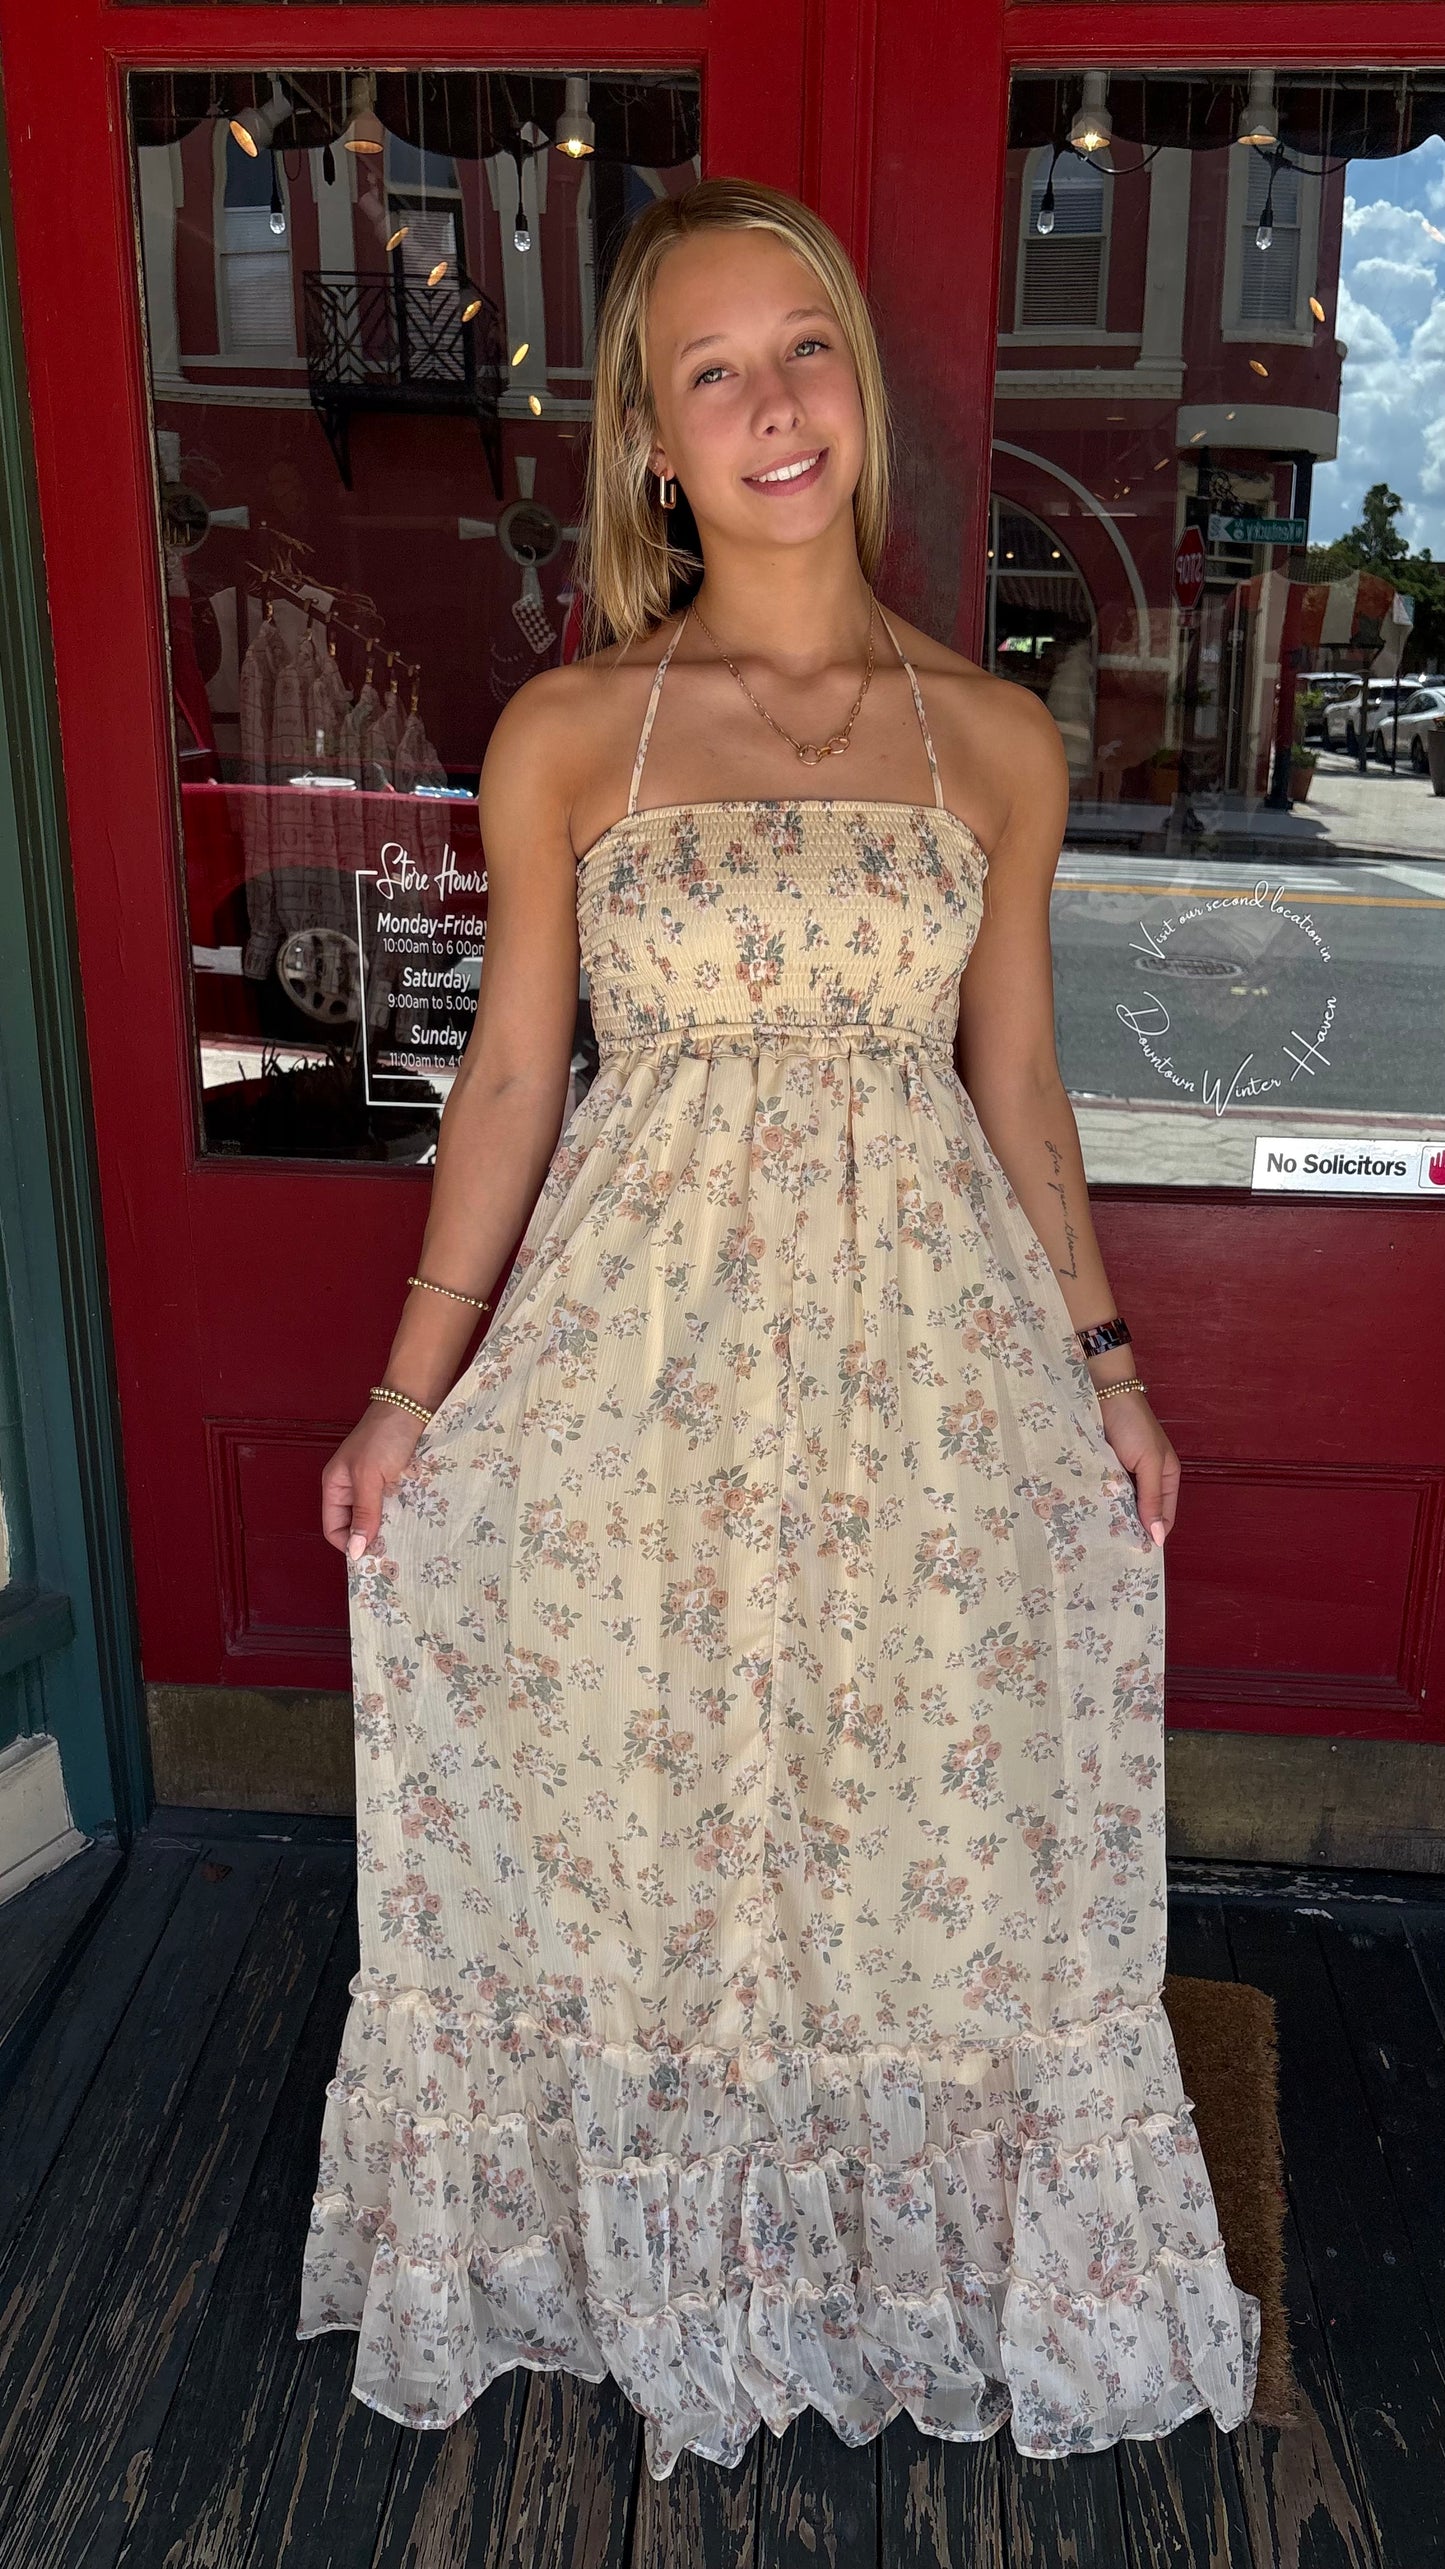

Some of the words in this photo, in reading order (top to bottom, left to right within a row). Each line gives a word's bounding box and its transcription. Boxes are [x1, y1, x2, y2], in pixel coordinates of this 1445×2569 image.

[376, 842, 430, 900] Store
[434, 843, 488, 902] Hours
[1129, 918, 1176, 960] Visit
[1179, 907, 1203, 925] our
[1206, 880, 1269, 912] second
[1270, 886, 1322, 947] location
[1319, 945, 1332, 963] in
[383, 937, 429, 954] 10:00am
[432, 940, 444, 955] to
[402, 966, 471, 993] Saturday
[388, 993, 430, 1009] 9:00am
[432, 995, 443, 1010] to
[410, 1024, 467, 1050] Sunday
[389, 1052, 431, 1068] 11:00am
[434, 1055, 445, 1069] to
[1115, 991, 1195, 1092] Downtown
[1202, 1053, 1282, 1117] Winter
[1282, 996, 1337, 1082] Haven
[1266, 1152, 1298, 1173] No
[1302, 1153, 1407, 1176] Solicitors
